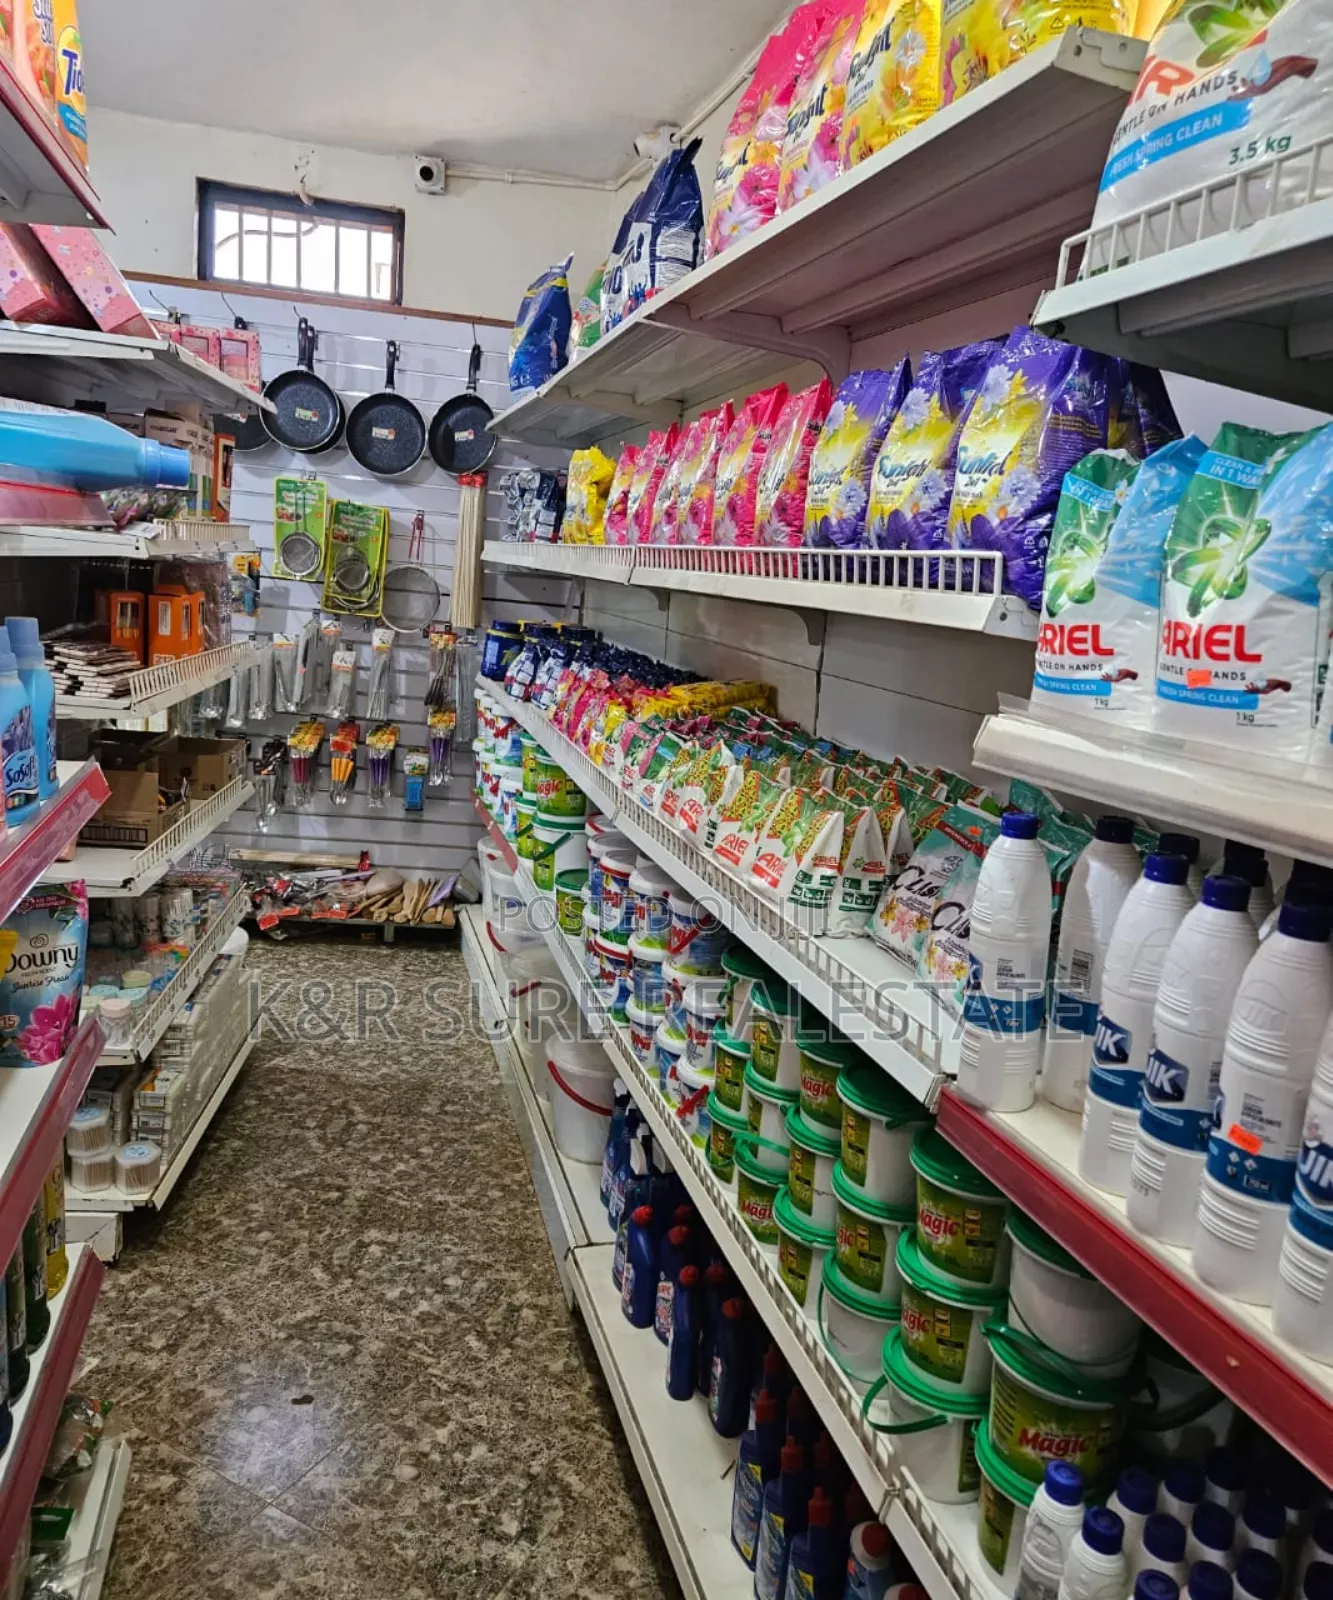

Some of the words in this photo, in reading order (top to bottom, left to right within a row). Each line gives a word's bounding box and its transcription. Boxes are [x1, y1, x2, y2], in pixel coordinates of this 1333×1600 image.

[1174, 69, 1238, 107] HANDS
[1134, 132, 1174, 162] SPRING
[1176, 112, 1224, 143] CLEAN
[1228, 139, 1260, 166] 3.5
[1264, 133, 1293, 155] kg
[1162, 619, 1262, 662] ARIEL
[1072, 682, 1097, 691] CLEAN
[1209, 668, 1246, 681] ANDS
[1208, 693, 1240, 704] CLEAN
[902, 1310, 931, 1334] agic
[1018, 1427, 1094, 1458] Magic
